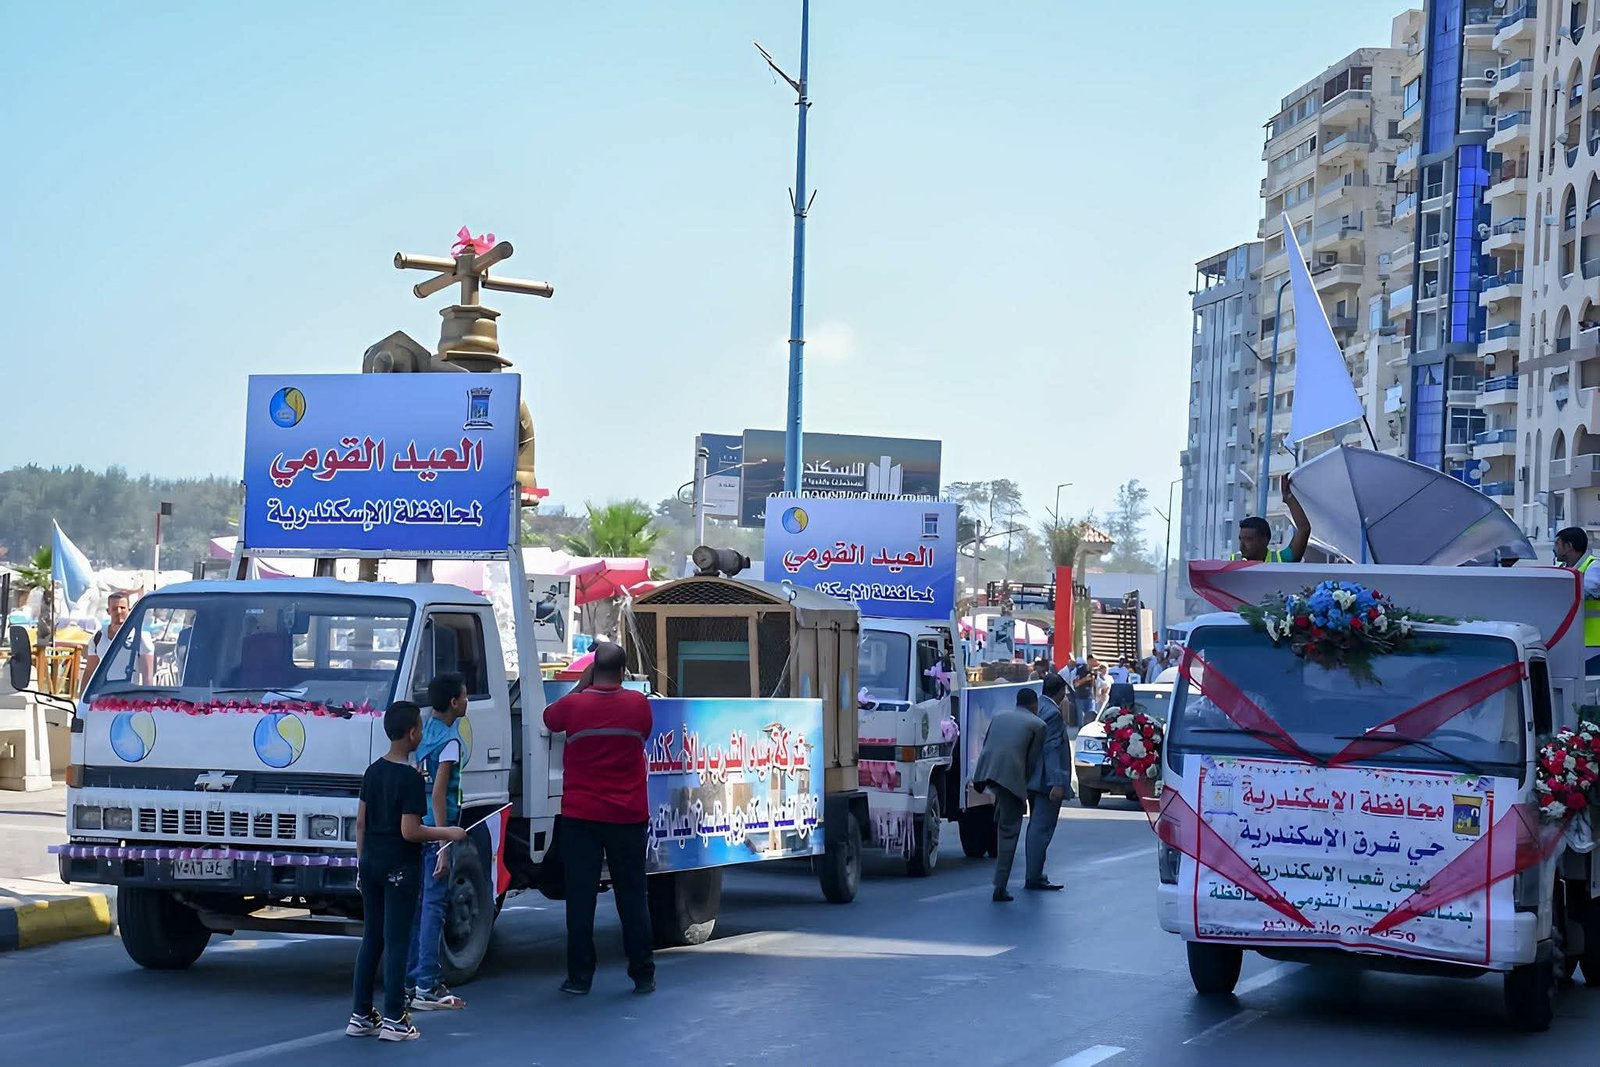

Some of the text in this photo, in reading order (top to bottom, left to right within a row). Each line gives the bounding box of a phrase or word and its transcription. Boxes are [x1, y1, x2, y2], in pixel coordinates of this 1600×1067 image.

[269, 435, 483, 487] العيد القومي
[267, 497, 483, 531] لمحافظة الإسكندرية
[783, 541, 934, 573] العيد القومي
[872, 583, 934, 603] لمحافظة
[1242, 781, 1445, 819] محافظة الإسكندرية
[1239, 818, 1445, 866] حي شرق الإسكندرية
[1251, 857, 1342, 887] الإسكندرية
[1347, 867, 1384, 890] شعب
